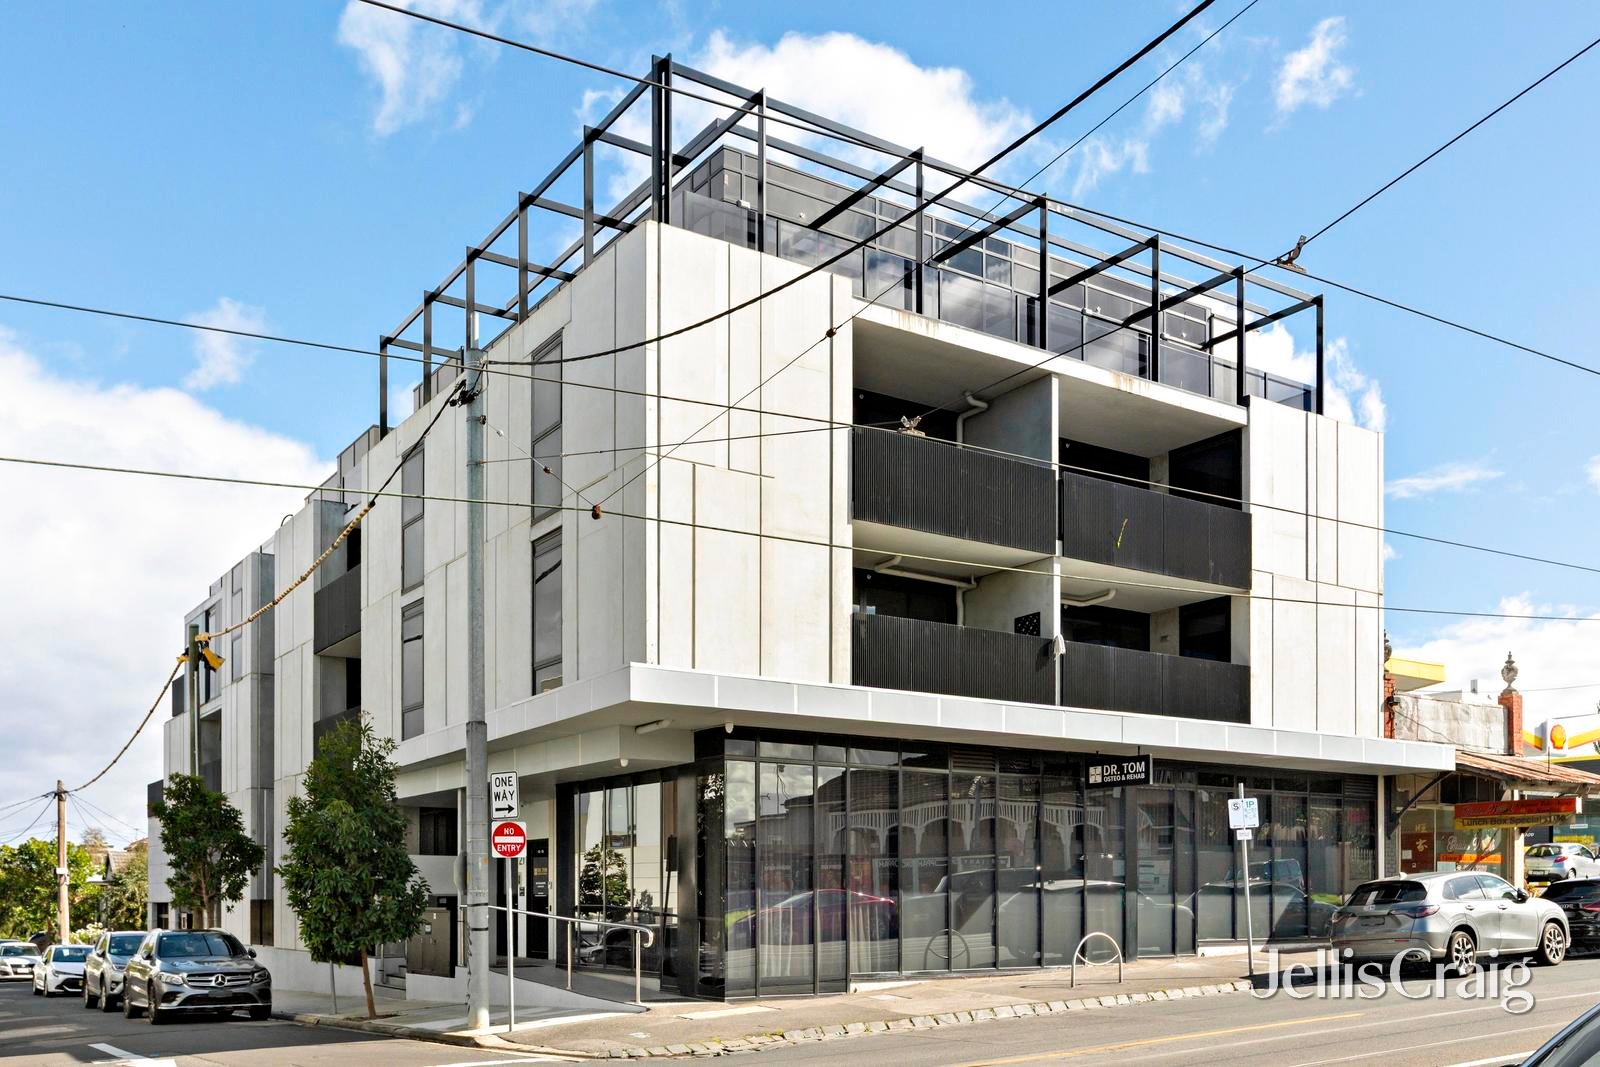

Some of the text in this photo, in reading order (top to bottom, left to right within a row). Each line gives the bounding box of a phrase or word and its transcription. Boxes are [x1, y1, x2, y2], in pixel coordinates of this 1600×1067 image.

[1103, 761, 1146, 776] DR. TOM
[1126, 772, 1146, 780] REHAB
[494, 776, 513, 788] ONE
[493, 790, 515, 801] WAY
[1245, 800, 1255, 808] 1P
